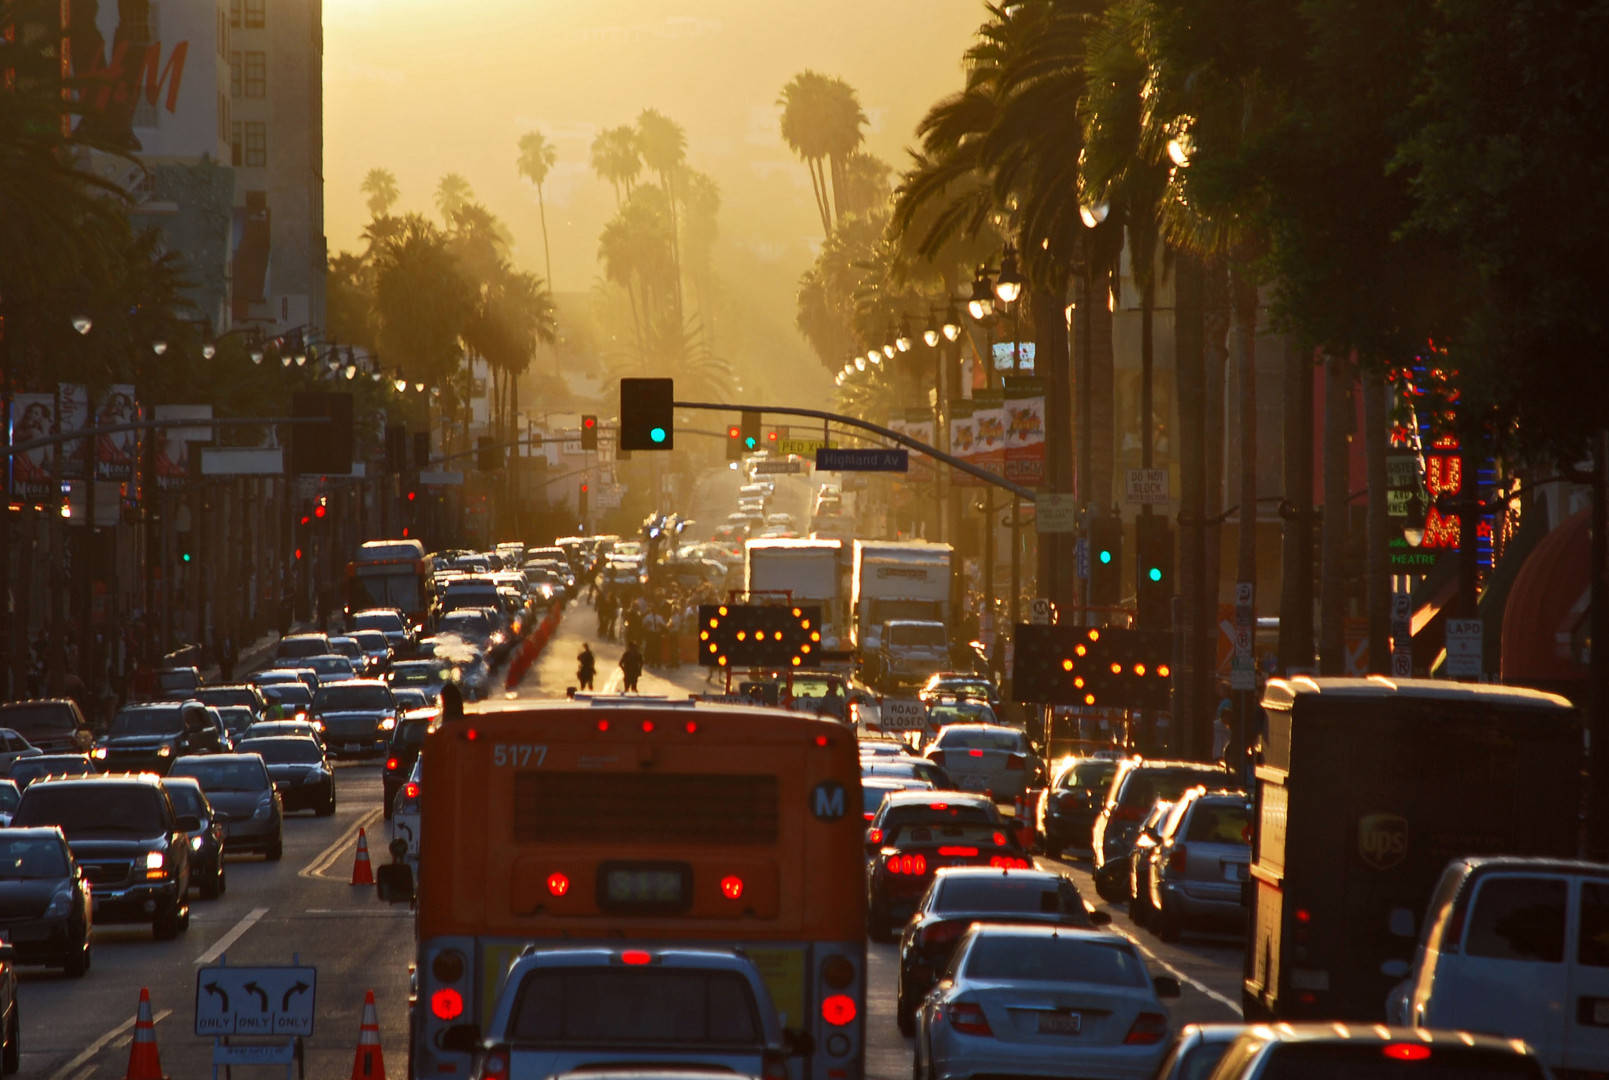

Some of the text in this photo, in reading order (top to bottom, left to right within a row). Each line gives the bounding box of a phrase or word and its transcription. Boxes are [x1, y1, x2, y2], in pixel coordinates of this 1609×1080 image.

[782, 442, 804, 452] PED
[825, 454, 900, 468] Highland Av
[1132, 471, 1163, 481] DO NOT
[1133, 482, 1161, 493] BLOCK
[1391, 553, 1436, 565] HEATRE
[891, 704, 918, 715] ROAD
[883, 716, 924, 726] CLOSED
[494, 744, 548, 767] 5177
[816, 787, 845, 816] M
[199, 1017, 309, 1028] ONLY ONLY ONLY
